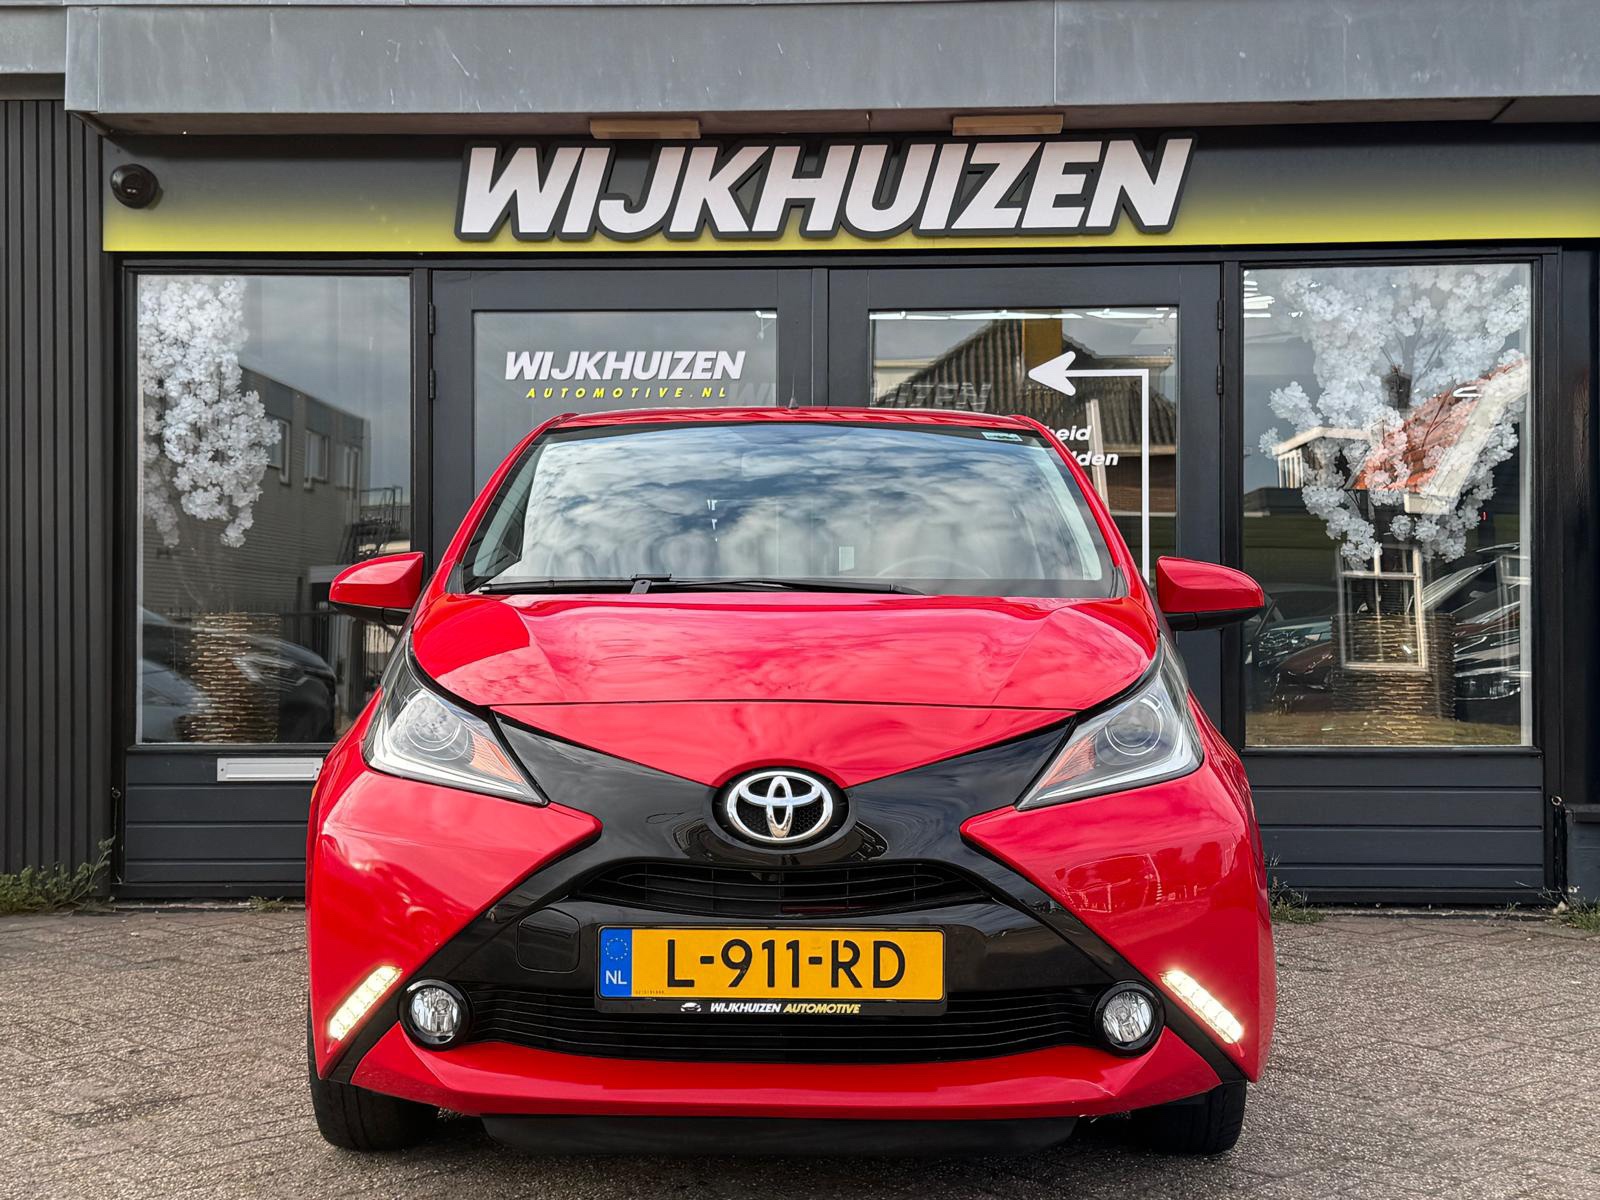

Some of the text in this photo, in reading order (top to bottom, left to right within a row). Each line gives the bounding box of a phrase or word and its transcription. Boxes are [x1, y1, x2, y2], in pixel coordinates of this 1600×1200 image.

[460, 137, 1194, 234] WIJKHUIZEN
[504, 350, 746, 381] WIJKHUIZEN
[525, 386, 727, 399] AUTOMOTIVE.NL
[666, 938, 907, 989] L-911-RD
[605, 970, 628, 985] NL
[710, 1002, 862, 1014] WIJKHUIZEN AUTOMOTIVE
